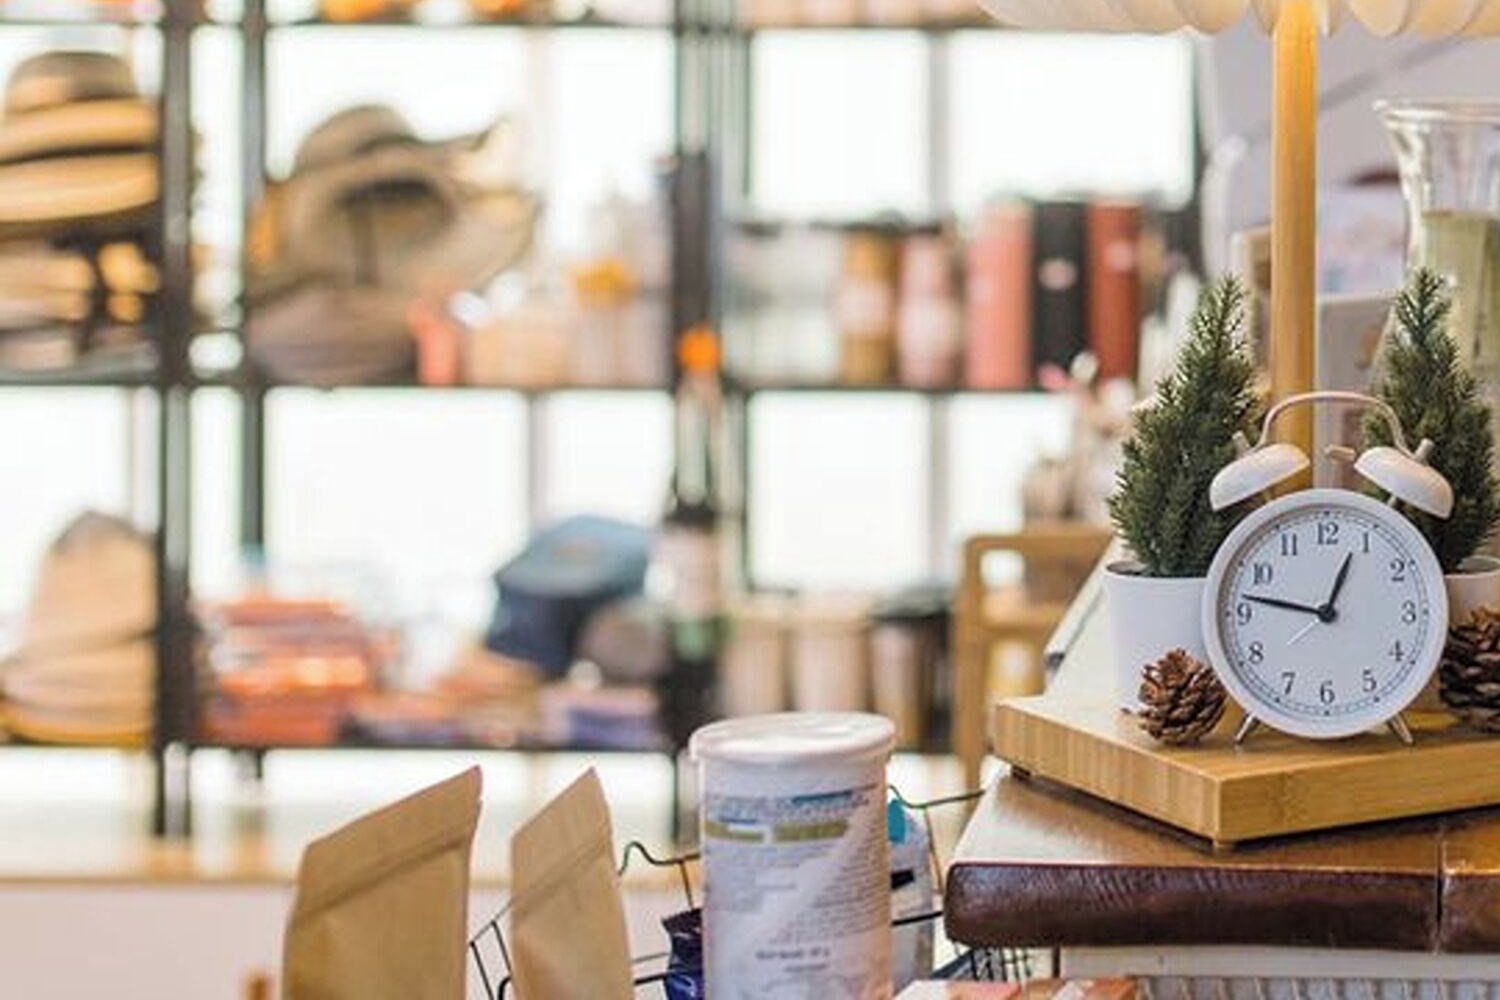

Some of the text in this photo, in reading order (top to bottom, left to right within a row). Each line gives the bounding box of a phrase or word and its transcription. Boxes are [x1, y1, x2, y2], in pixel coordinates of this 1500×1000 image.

[1280, 533, 1298, 556] 11
[1317, 521, 1340, 545] 12
[1361, 531, 1370, 554] 1
[1253, 562, 1273, 585] 10
[1390, 560, 1406, 582] 2
[1237, 603, 1252, 626] 9
[1401, 602, 1417, 625] 3
[1248, 642, 1264, 664] 8
[1388, 640, 1405, 663] 4
[1282, 671, 1297, 696] 7
[1319, 680, 1336, 704] 6
[1362, 670, 1377, 692] 5
